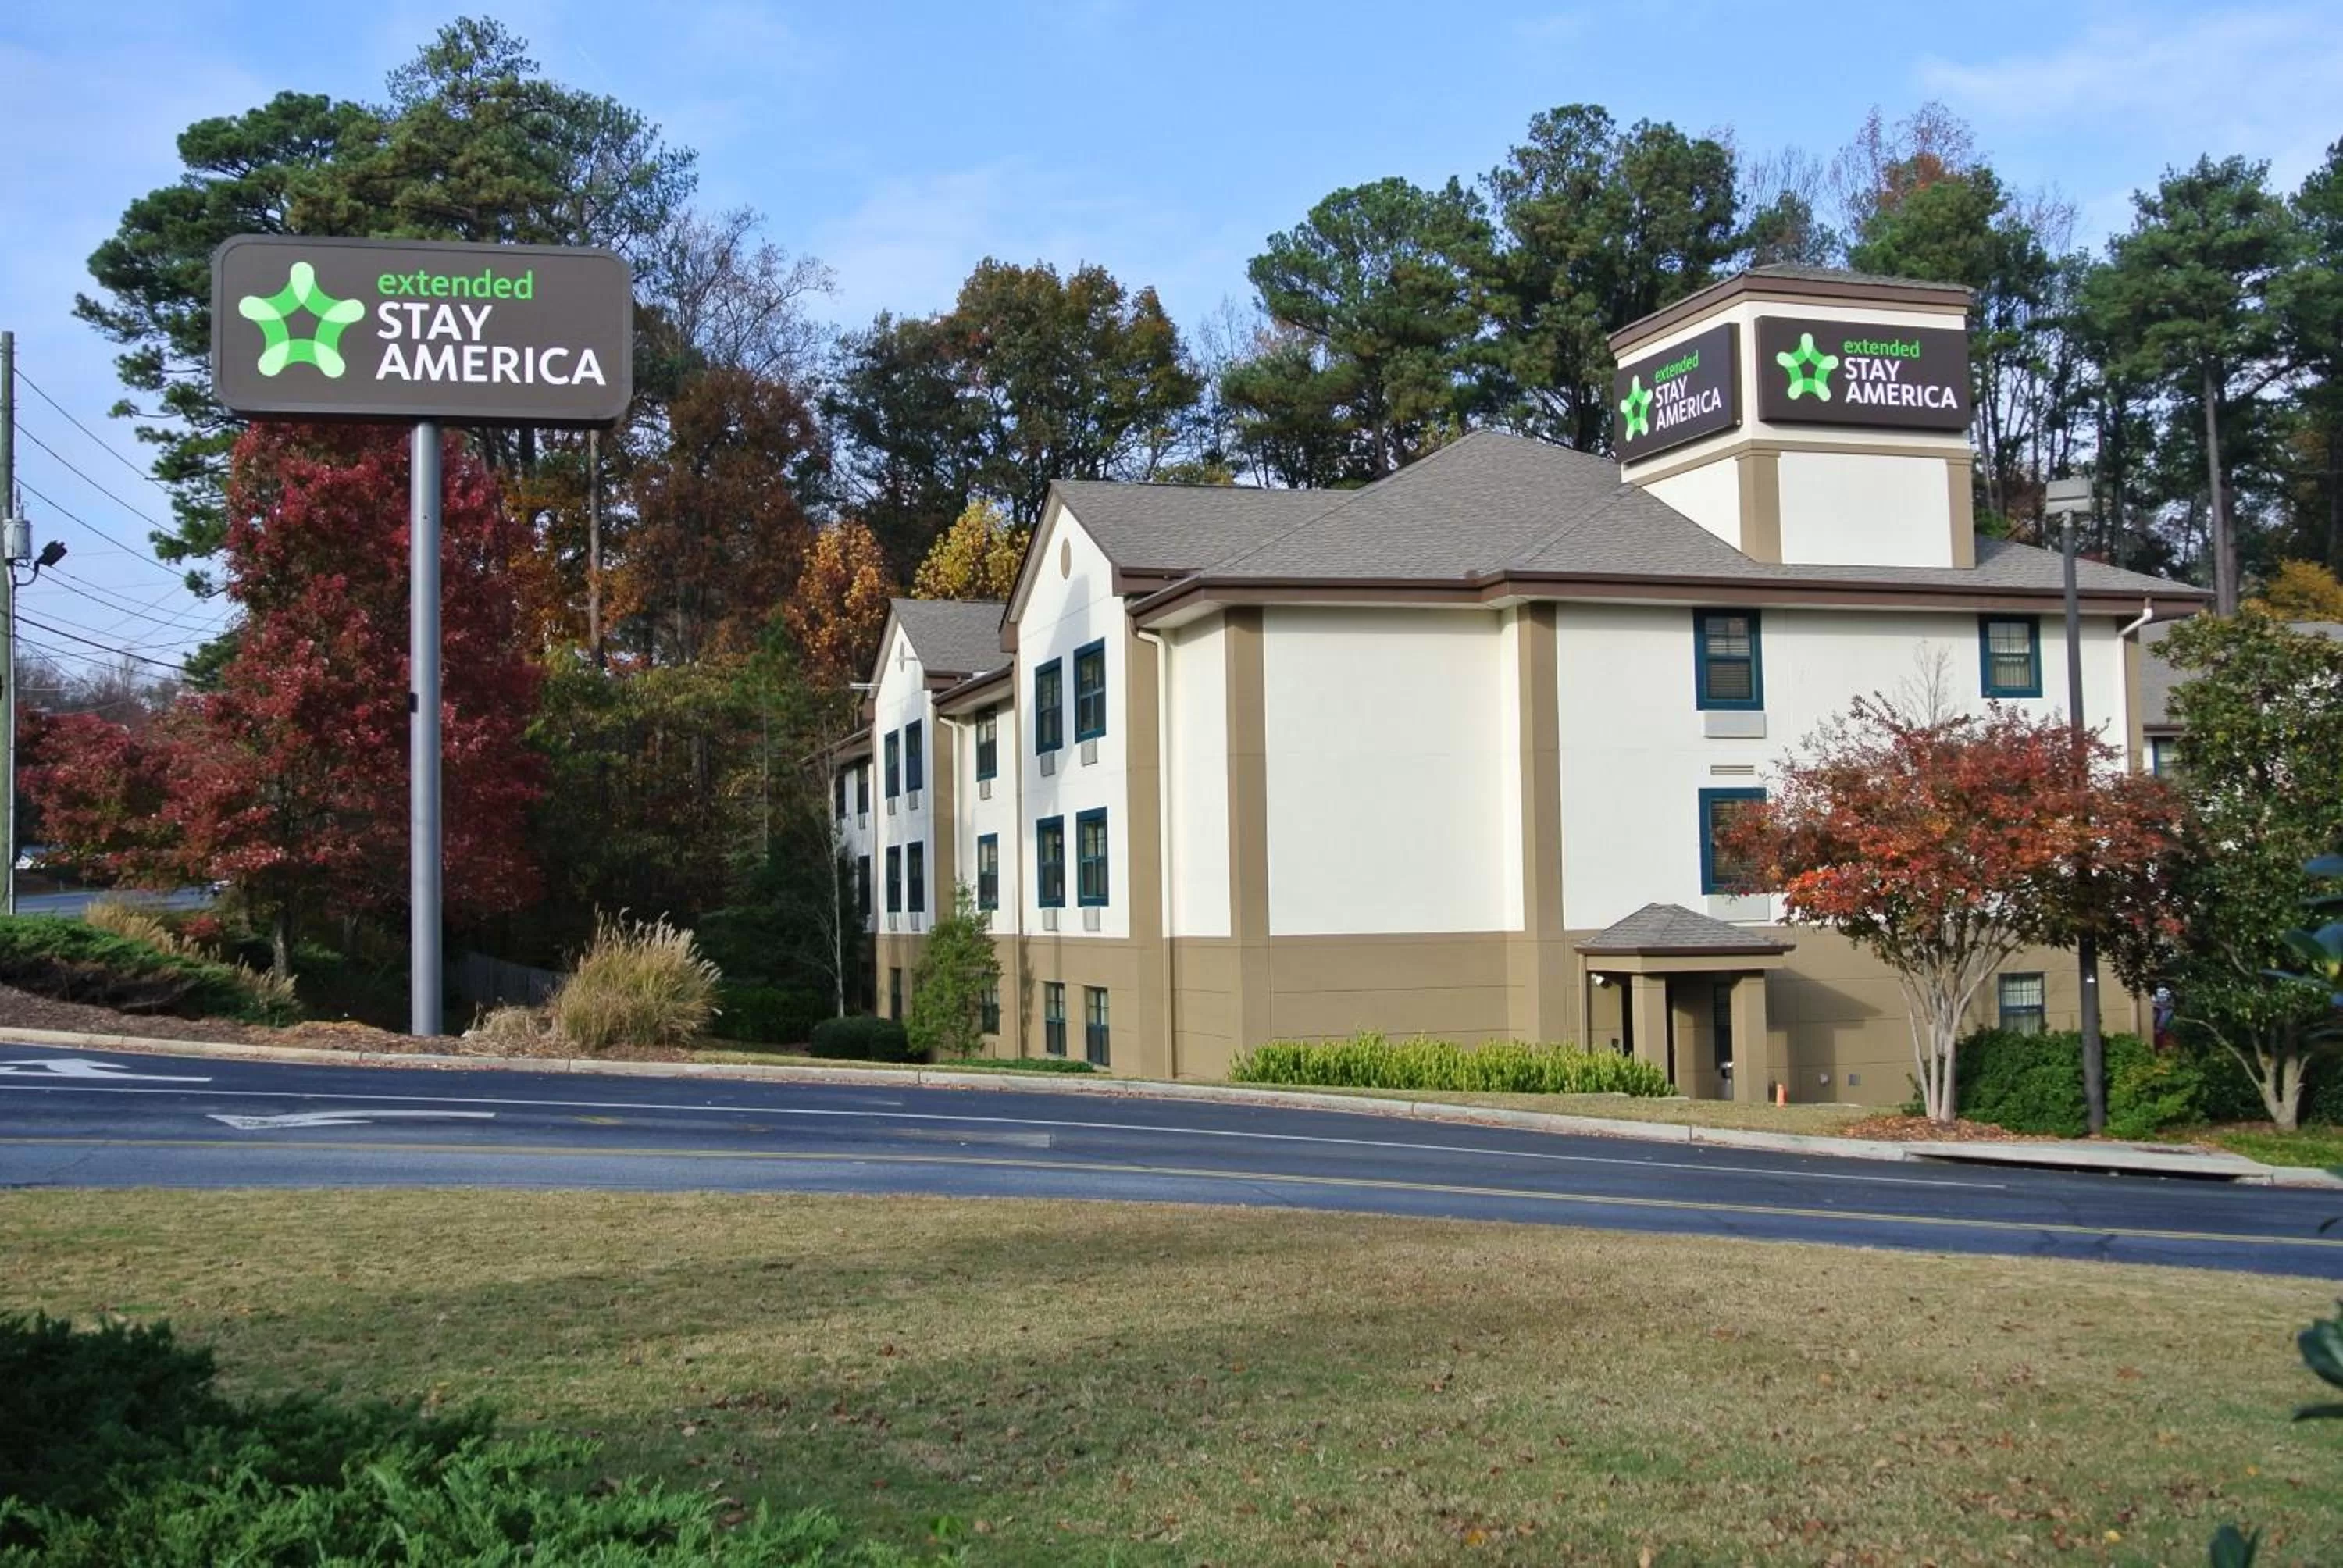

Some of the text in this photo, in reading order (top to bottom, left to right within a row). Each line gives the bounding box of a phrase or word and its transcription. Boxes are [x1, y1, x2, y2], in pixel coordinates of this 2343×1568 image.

[377, 268, 533, 300] extended
[376, 302, 492, 341] STAY
[376, 343, 606, 385] AMERICA
[1844, 338, 1920, 358] extended
[1655, 350, 1699, 383] extended
[1844, 357, 1901, 382] STAY
[1655, 375, 1688, 408] STAY
[1846, 383, 1958, 409] AMERICA
[1656, 387, 1722, 432] AMERICA
